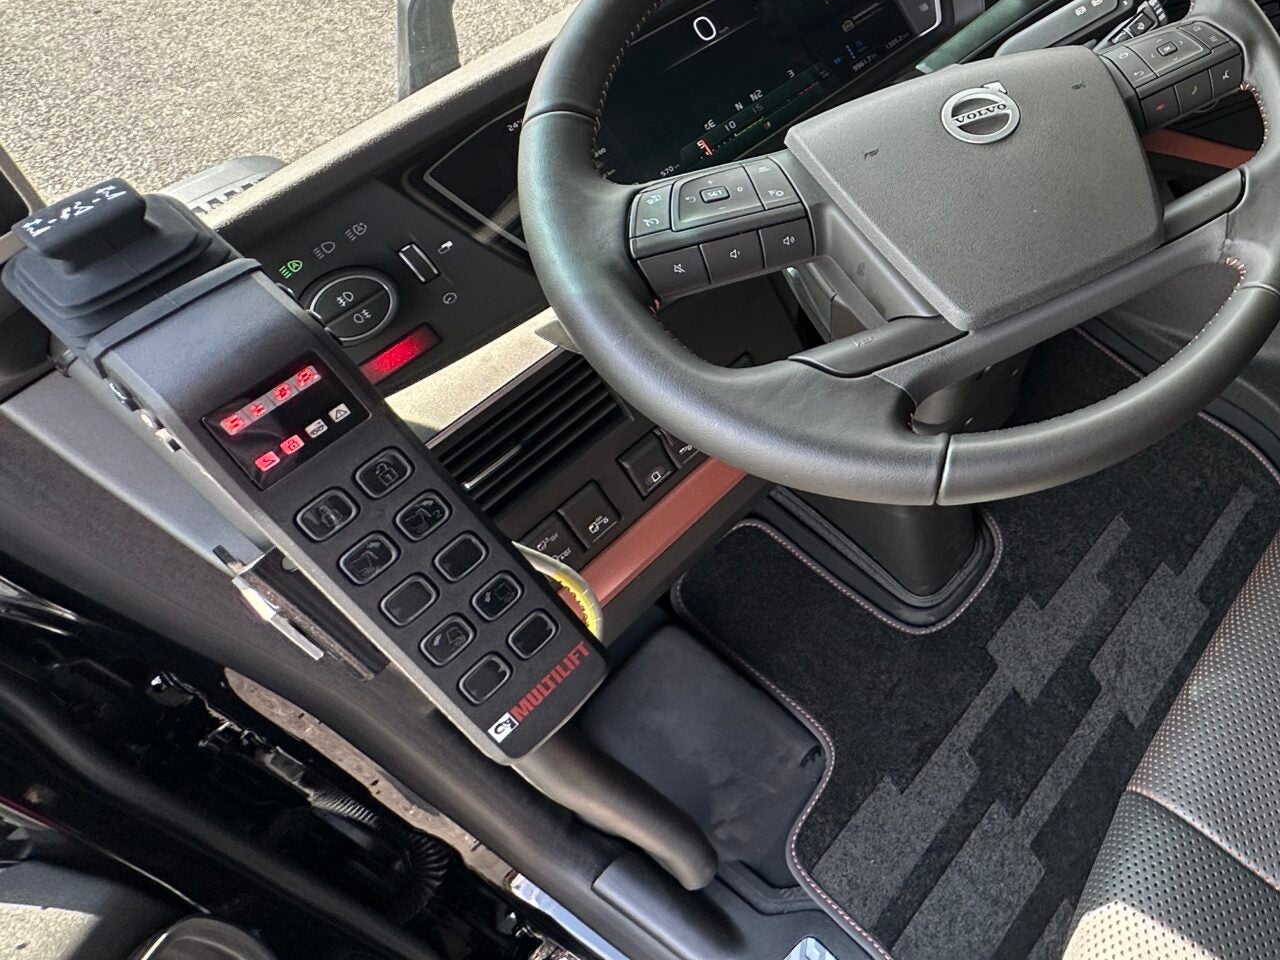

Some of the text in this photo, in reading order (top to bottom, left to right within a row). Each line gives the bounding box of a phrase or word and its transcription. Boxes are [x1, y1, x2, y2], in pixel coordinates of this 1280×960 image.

[692, 15, 717, 41] 0
[954, 103, 1007, 123] VOLVO
[510, 640, 590, 722] MULTILIFT
